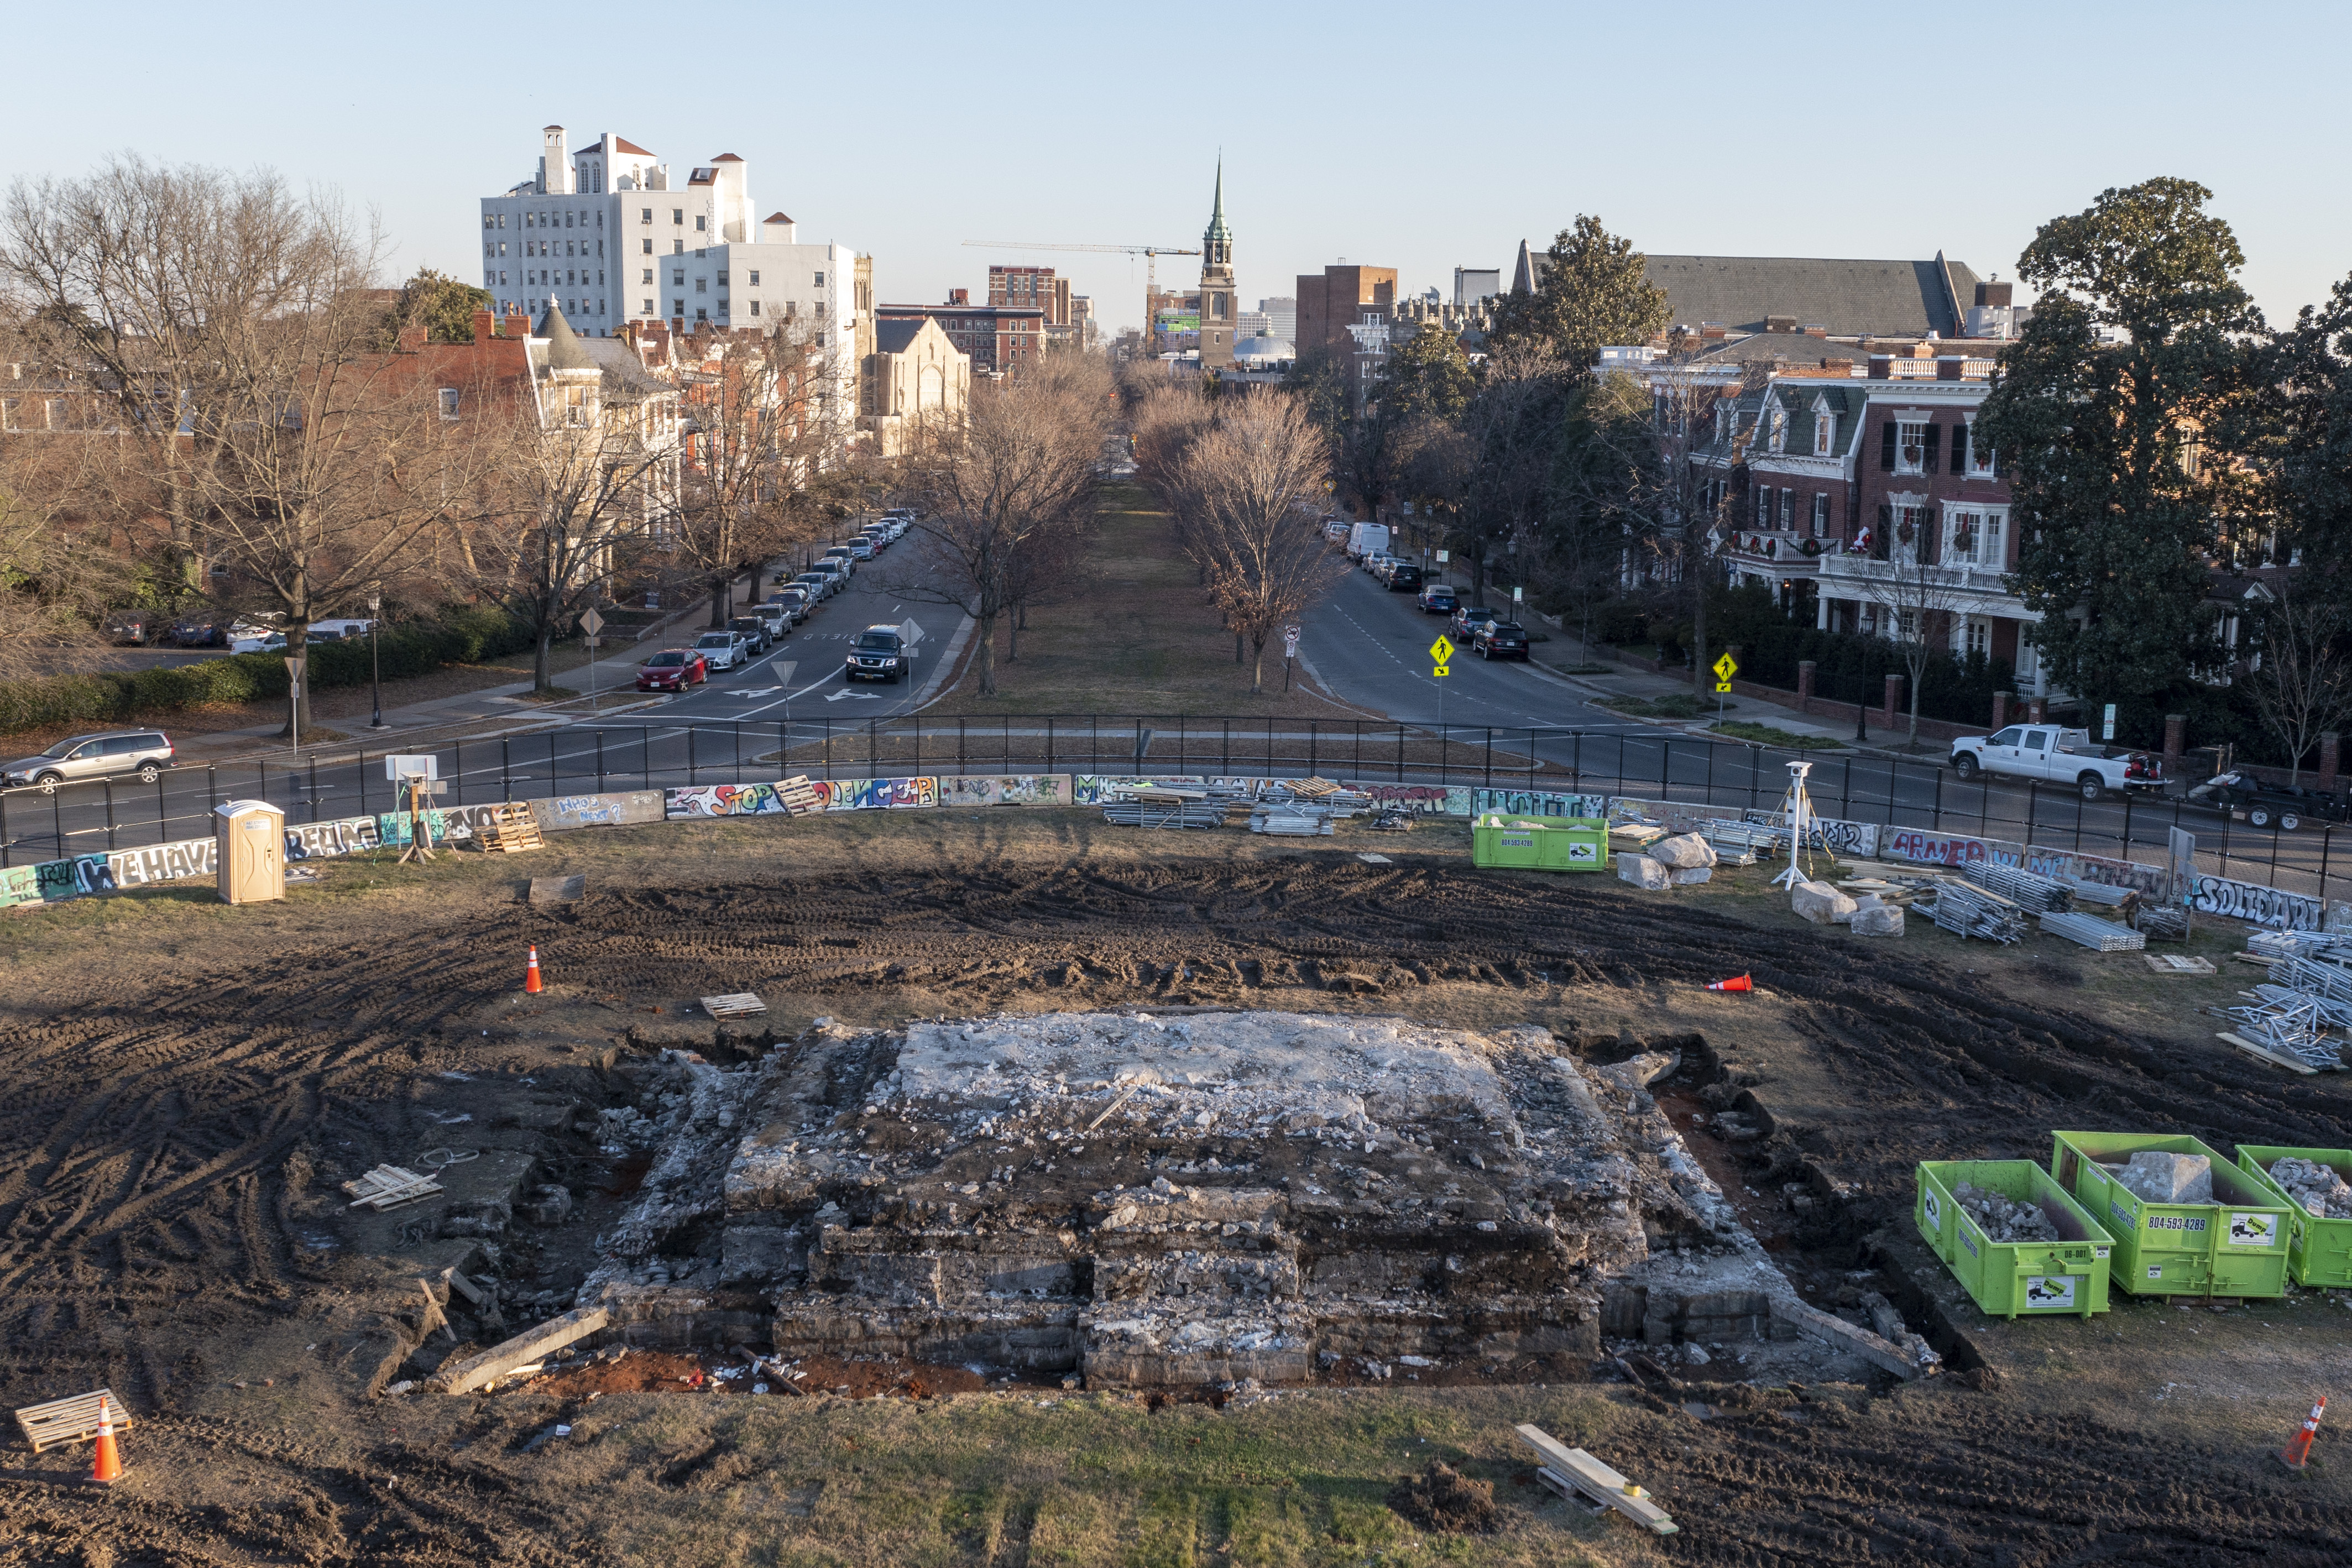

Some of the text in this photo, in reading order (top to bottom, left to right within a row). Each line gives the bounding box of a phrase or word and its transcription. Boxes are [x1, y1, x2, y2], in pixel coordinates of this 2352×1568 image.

[557, 796, 599, 816] WHO'S
[710, 785, 772, 816] STOP
[579, 809, 609, 822] NEXT
[1648, 806, 1680, 820] fucked
[284, 819, 380, 860] REAM
[2148, 1216, 2205, 1231] 804-593-4289
[2247, 1217, 2266, 1233] Dump
[2064, 1250, 2086, 1258] 06-001
[2043, 1280, 2064, 1294] Dump
